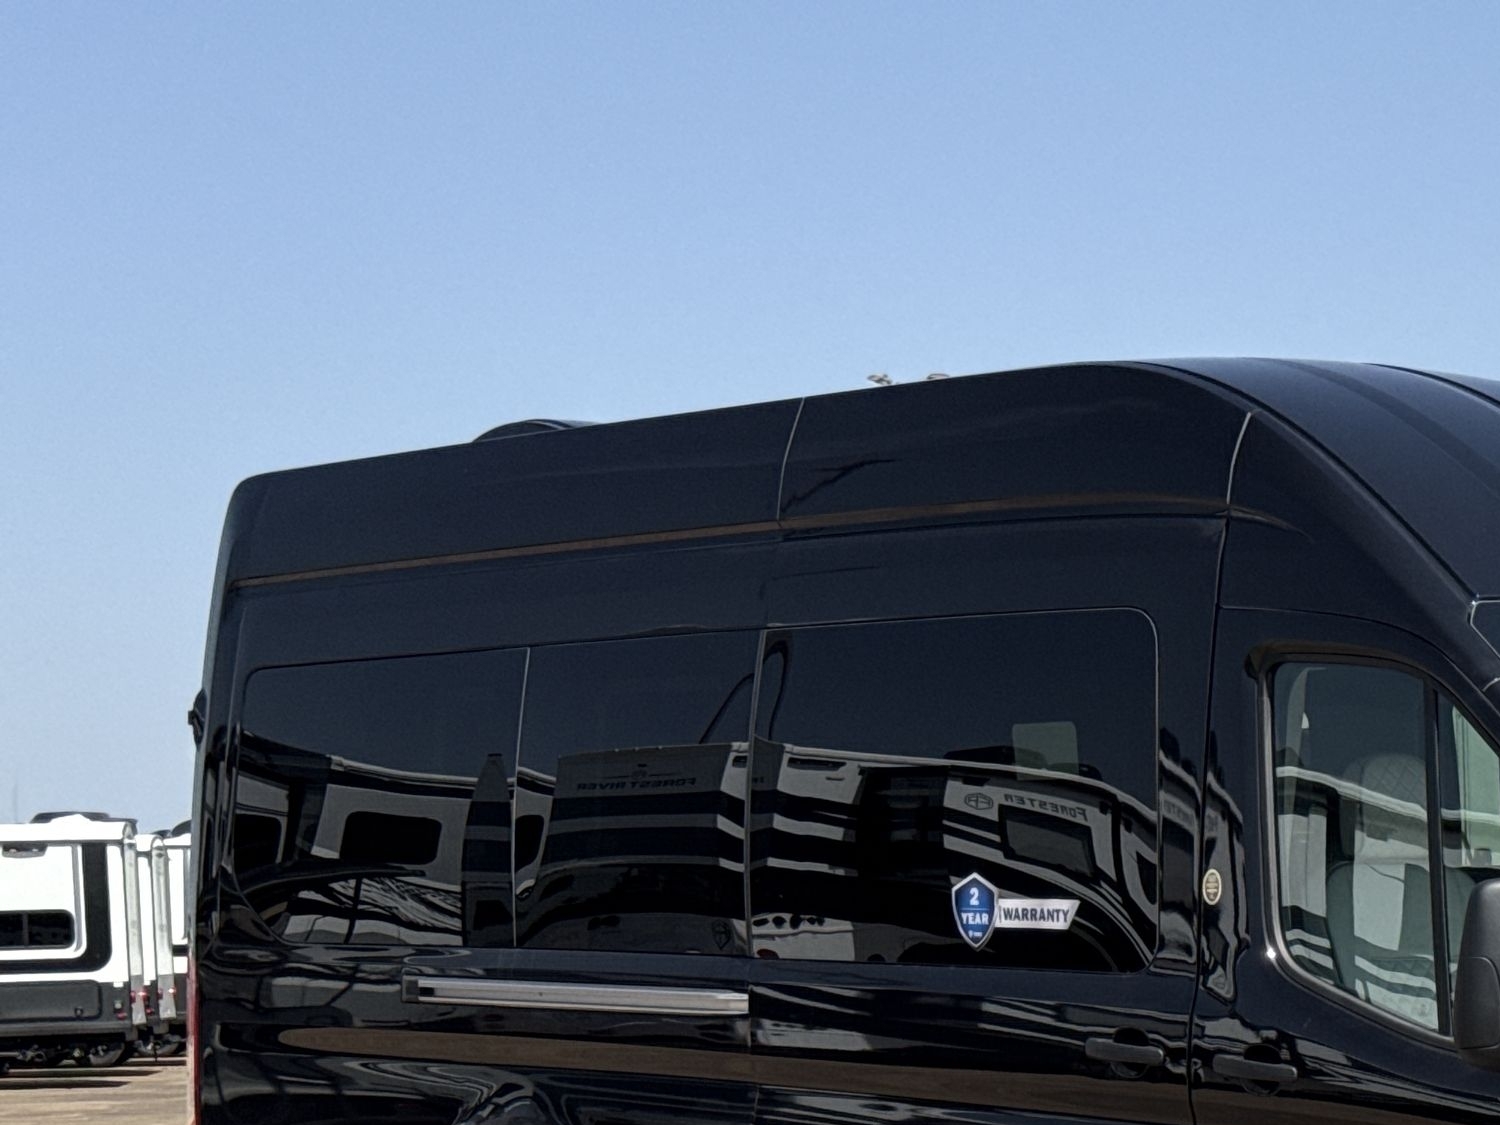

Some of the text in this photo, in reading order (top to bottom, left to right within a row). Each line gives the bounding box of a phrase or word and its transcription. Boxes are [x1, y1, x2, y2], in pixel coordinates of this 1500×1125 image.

[968, 886, 980, 906] 2
[961, 912, 989, 925] YEAR
[1003, 907, 1070, 922] WARRANTY
